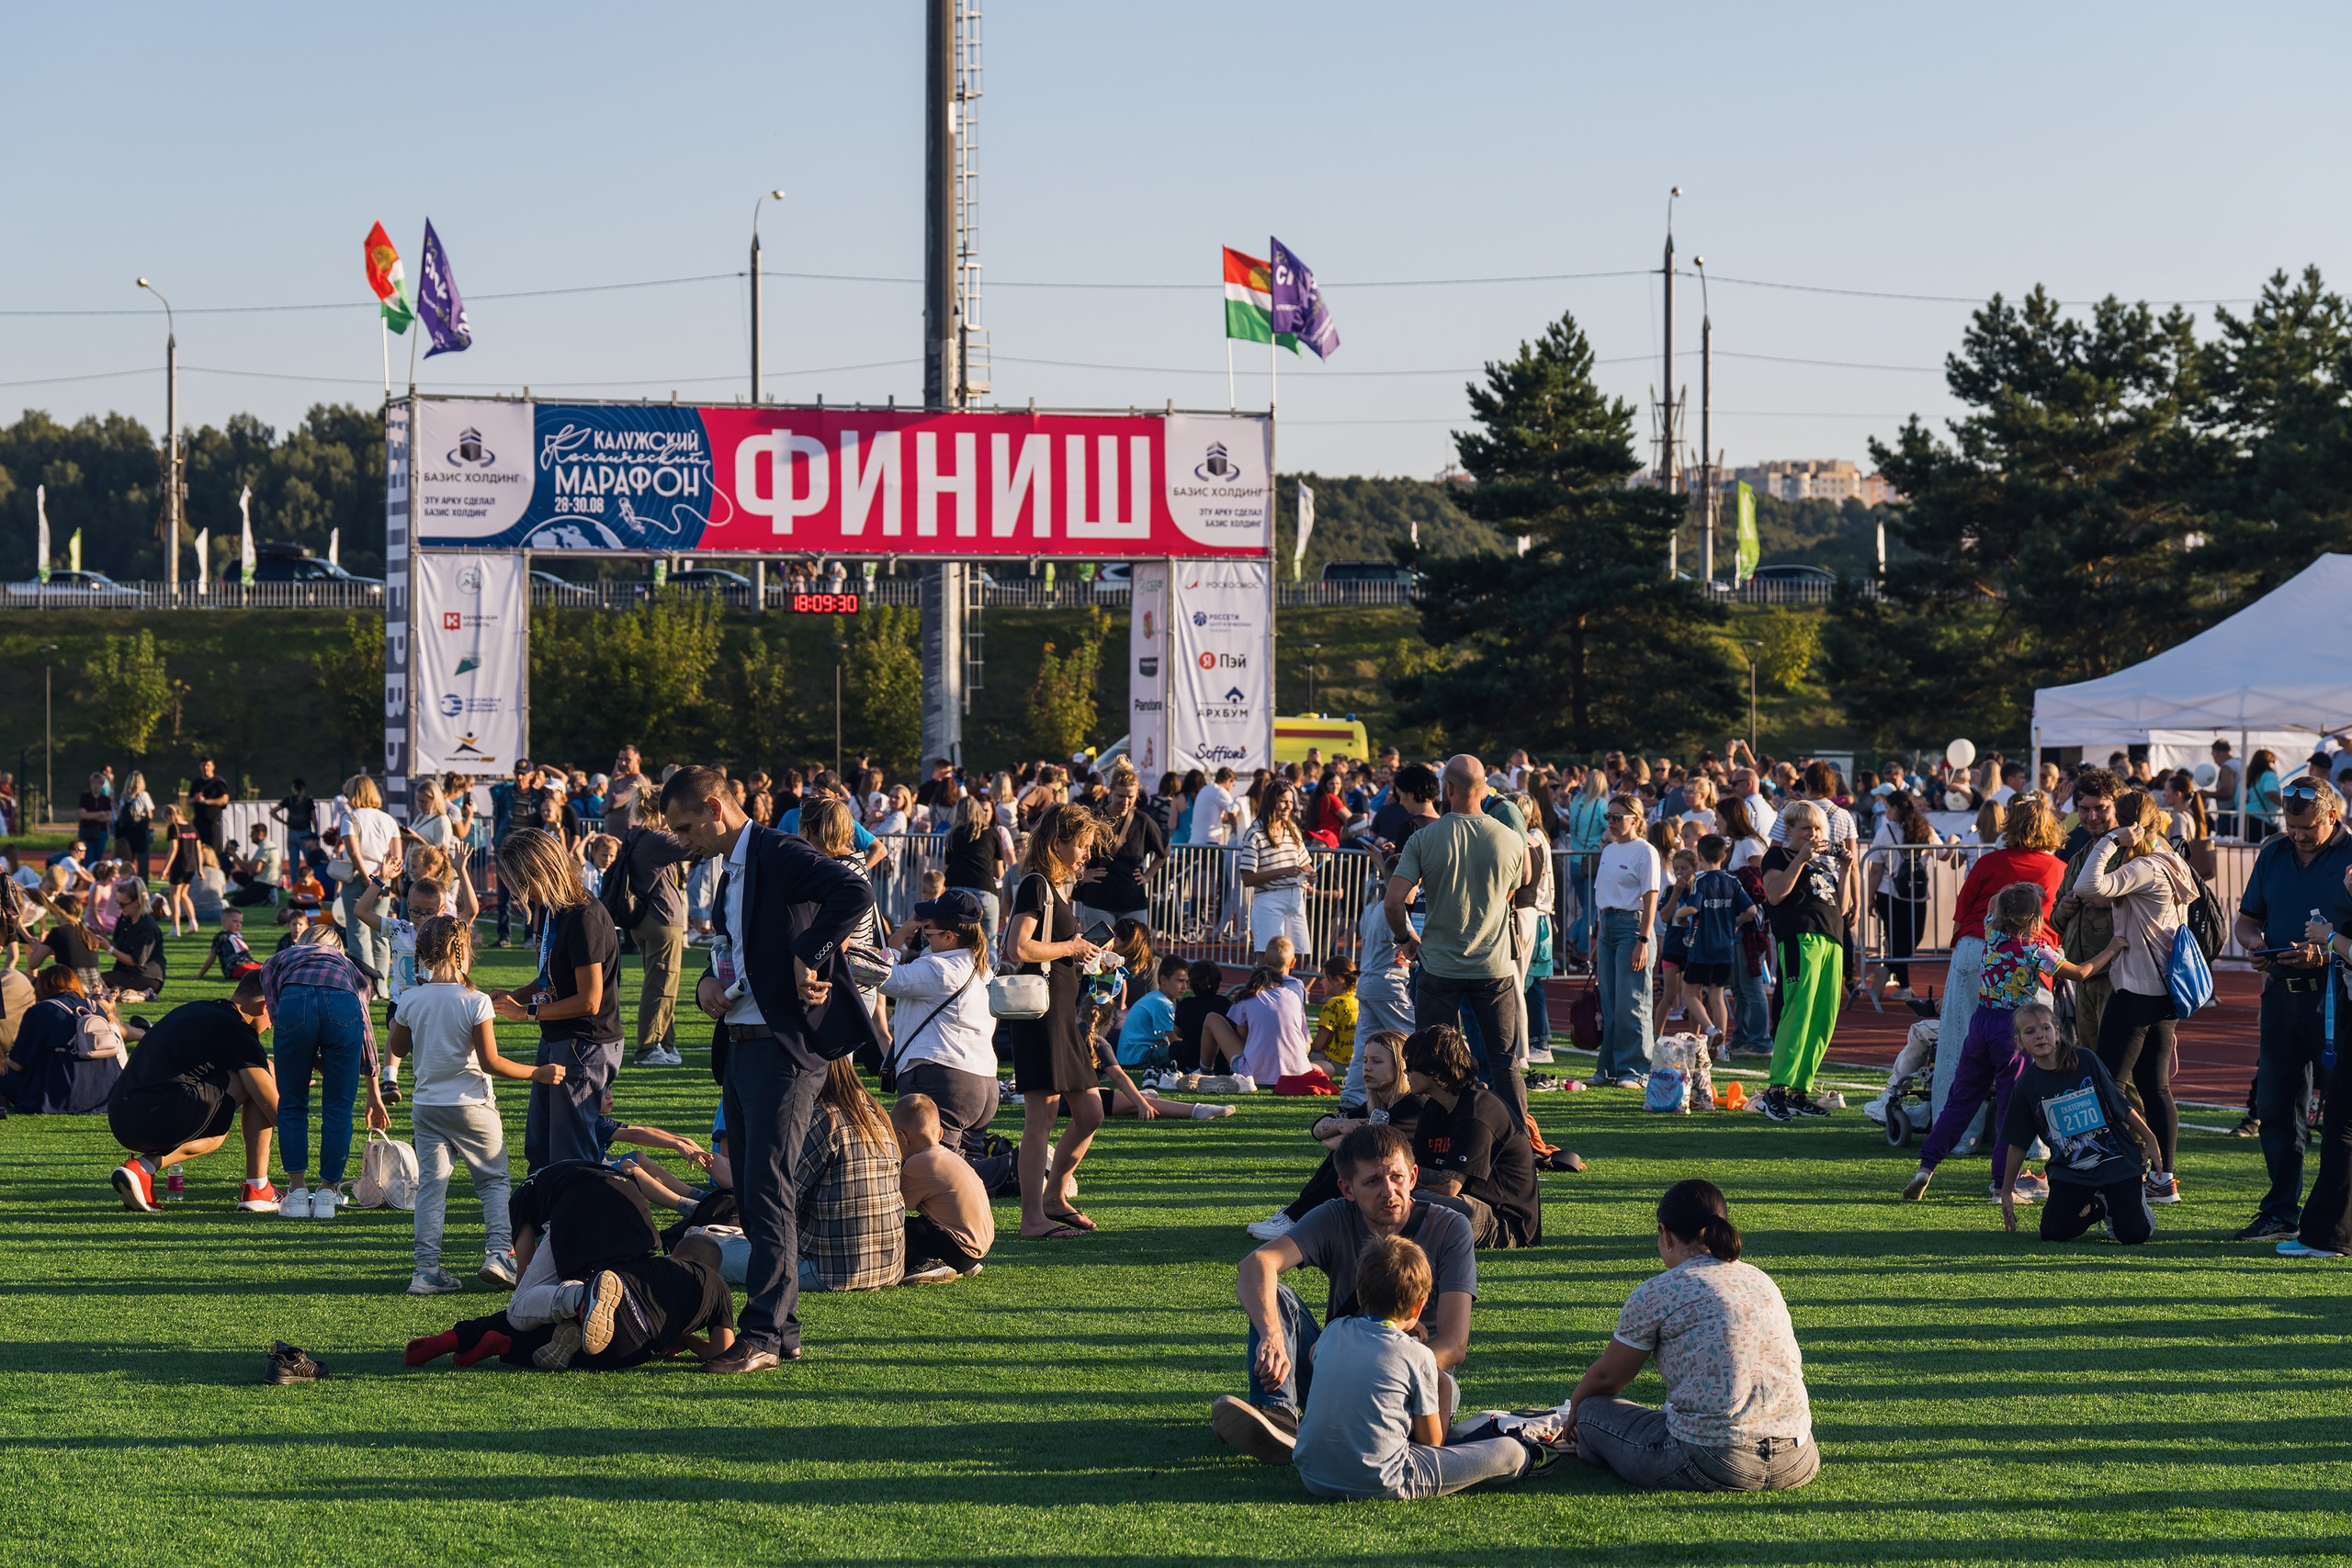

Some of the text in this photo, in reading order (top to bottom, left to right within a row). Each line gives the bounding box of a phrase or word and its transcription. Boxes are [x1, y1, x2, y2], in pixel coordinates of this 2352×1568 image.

[594, 429, 699, 451] КАЛУЖСКИЙ
[424, 472, 520, 484] БАЗИС ХОЛДИНГ
[555, 465, 699, 497] МАРАФОН
[734, 428, 1150, 538] ФИНИШ
[1173, 487, 1263, 498] БАЗИС ХОЛДИНГ
[424, 496, 496, 506] ЭТУ АРКУ СДЕЛАЛ
[554, 496, 605, 513] 28-30.08
[424, 509, 488, 518] БАЗИС ХОЛДИНГ
[1199, 508, 1263, 518] ЭТУ АРКУ СДЕЛАЛ
[1205, 519, 1261, 528] БАЗИС ХОЛДИНГ
[794, 593, 858, 614] 18:09:30
[1219, 652, 1247, 669] Пэй
[1134, 698, 1162, 711] Pandora
[1197, 708, 1249, 718] АРХБУМ
[2061, 1099, 2093, 1114] ЕКАТЕРИНА
[2064, 1107, 2099, 1132] 2170
